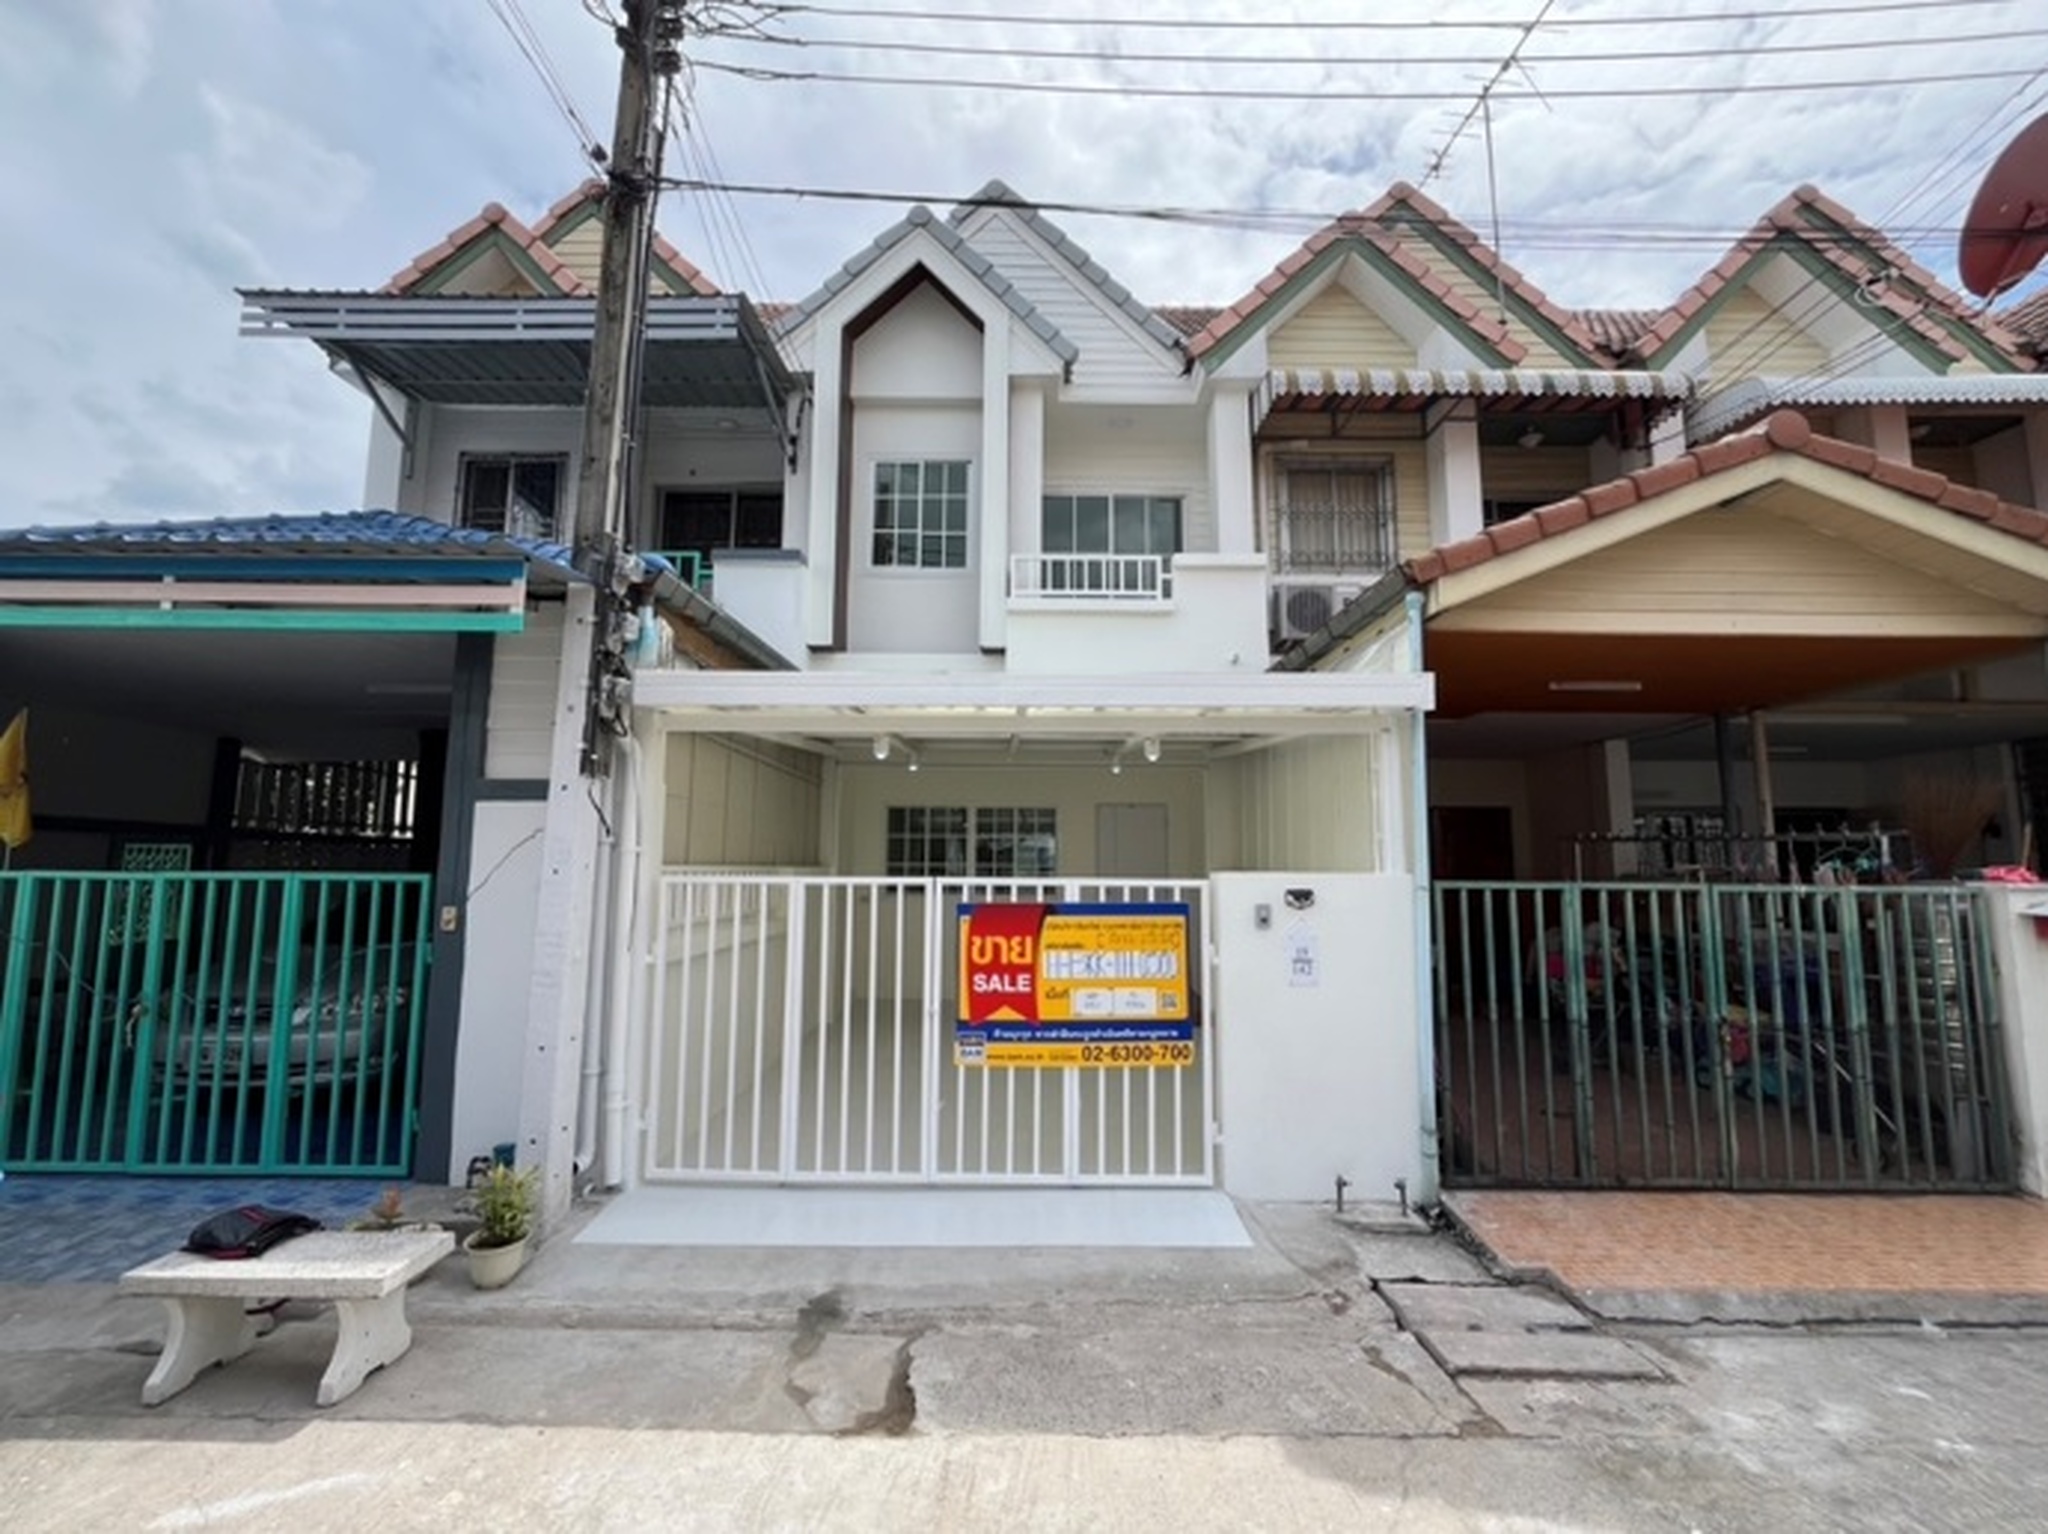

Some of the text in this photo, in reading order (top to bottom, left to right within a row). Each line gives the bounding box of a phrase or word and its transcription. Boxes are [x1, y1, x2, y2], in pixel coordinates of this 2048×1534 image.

[971, 935, 1032, 965] ขาย
[973, 974, 1032, 992] SALE
[1081, 1044, 1192, 1063] 02-6300-700
